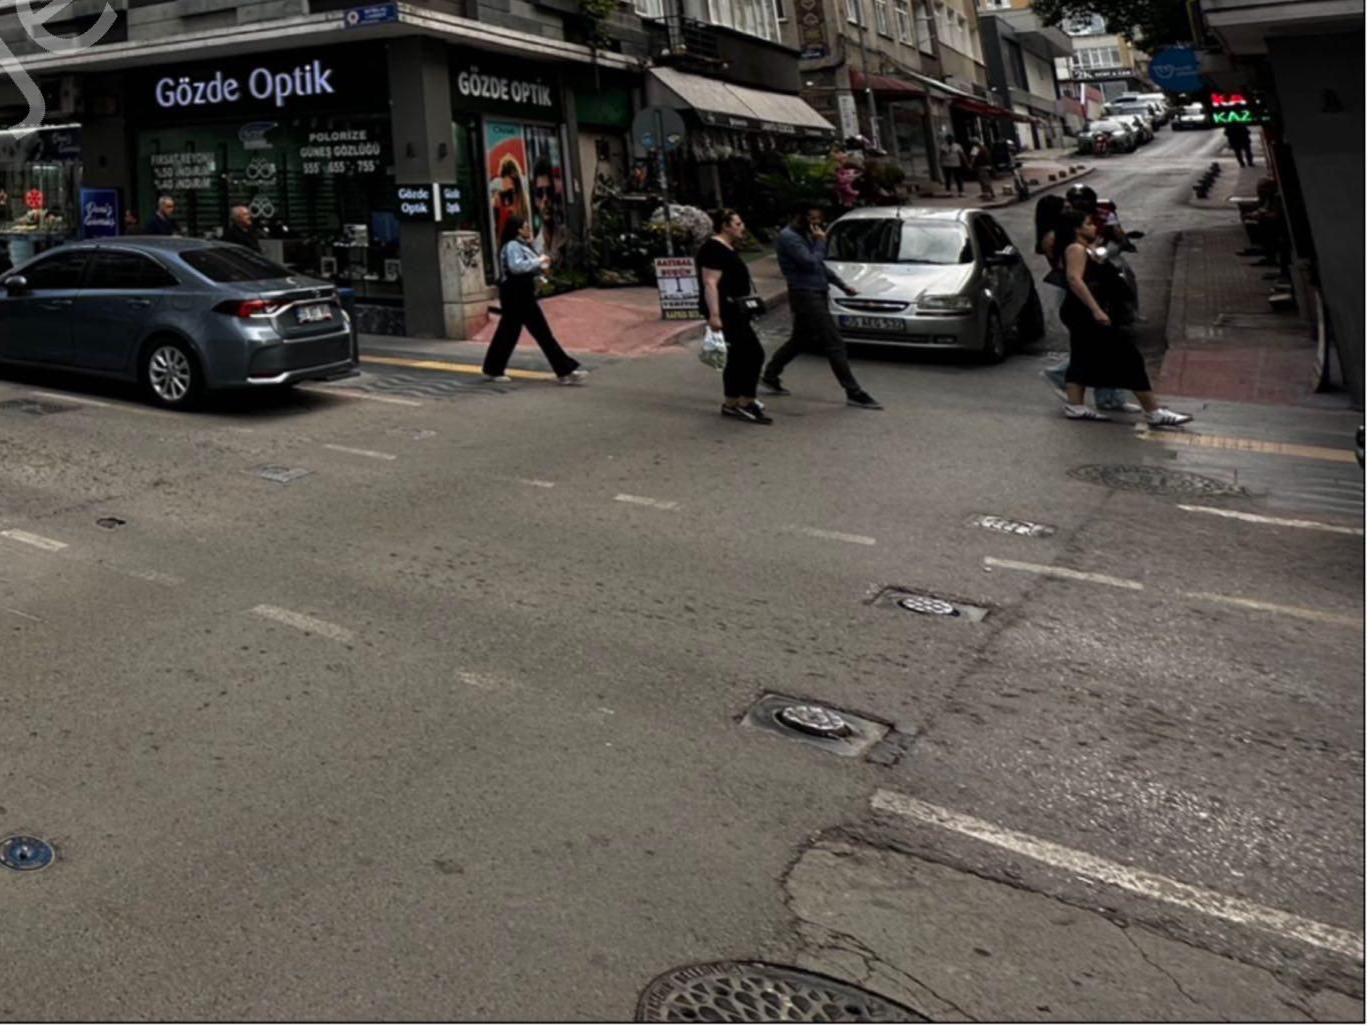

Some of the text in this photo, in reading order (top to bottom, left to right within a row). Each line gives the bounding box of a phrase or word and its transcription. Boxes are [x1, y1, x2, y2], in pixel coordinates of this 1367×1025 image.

[155, 59, 336, 108] Gözde Optik
[458, 65, 553, 107] GÖZDE OPTİK
[300, 141, 381, 159] GÜNEŞ GÖZLÜĞÜ
